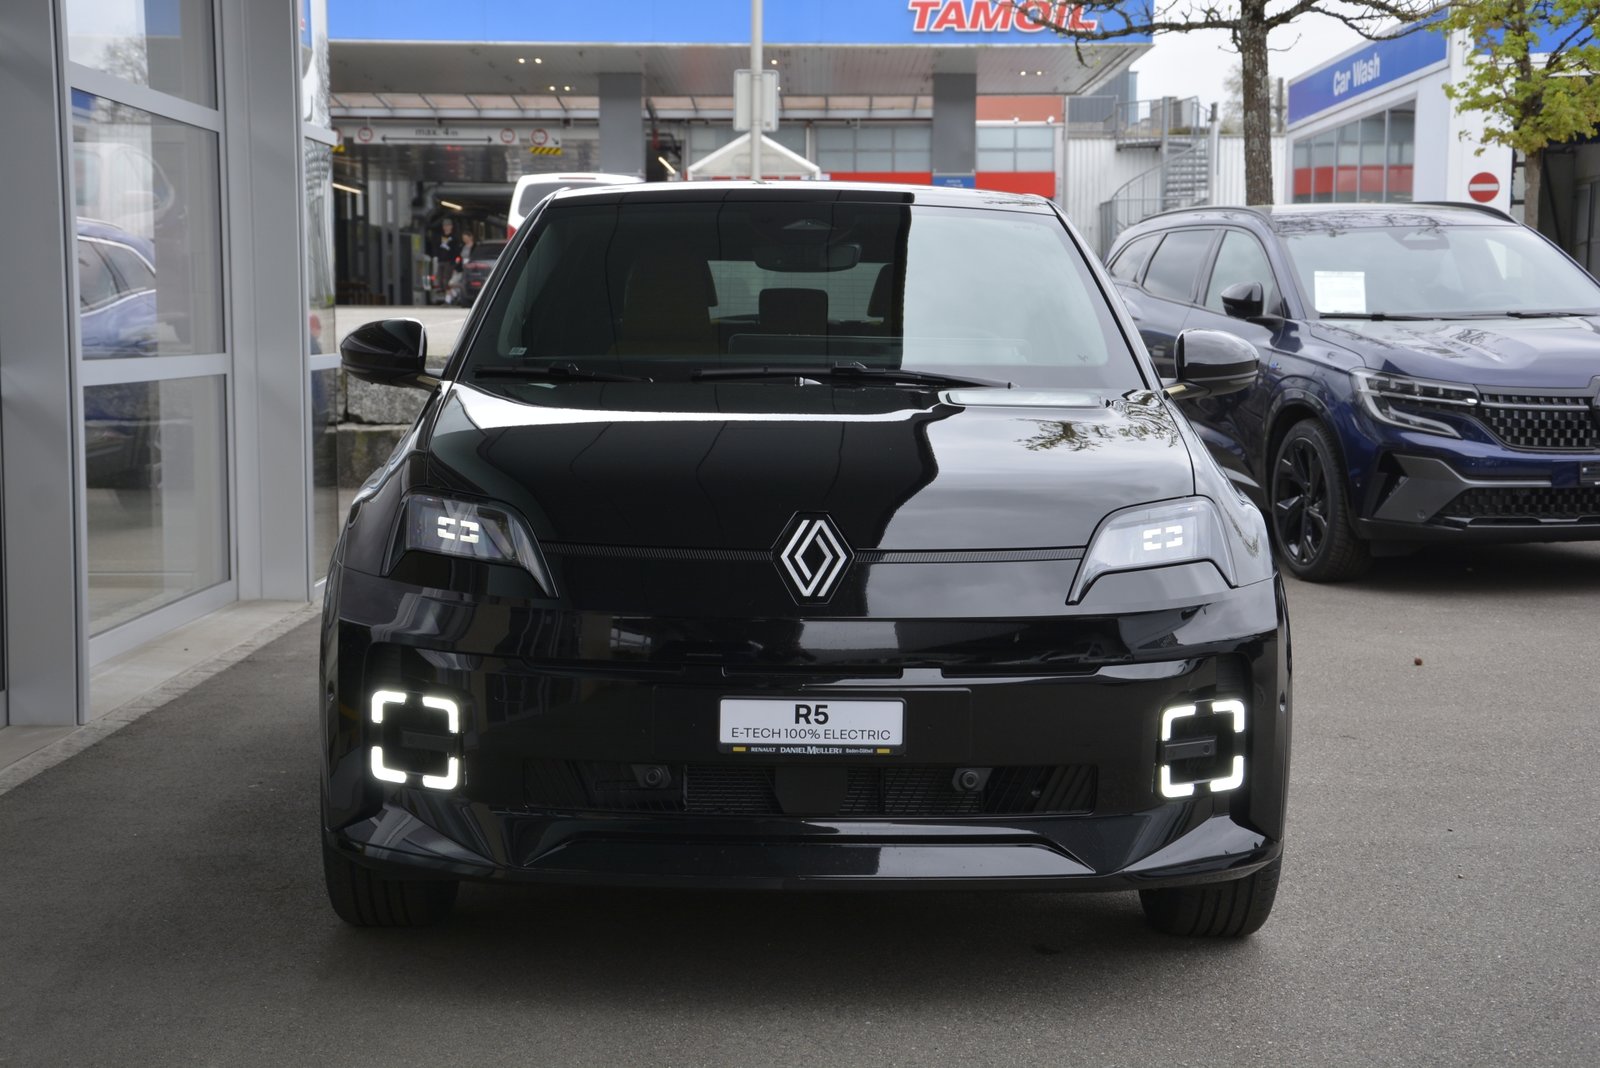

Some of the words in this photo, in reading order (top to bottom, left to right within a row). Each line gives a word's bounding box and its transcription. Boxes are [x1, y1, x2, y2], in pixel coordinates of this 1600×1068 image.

[908, 0, 1097, 33] TAMOIL
[1333, 69, 1351, 97] Car
[1352, 52, 1381, 87] Wash
[794, 703, 830, 726] R5
[731, 727, 782, 740] E-TECH
[784, 728, 821, 741] 100%
[823, 729, 892, 742] ELECTRIC
